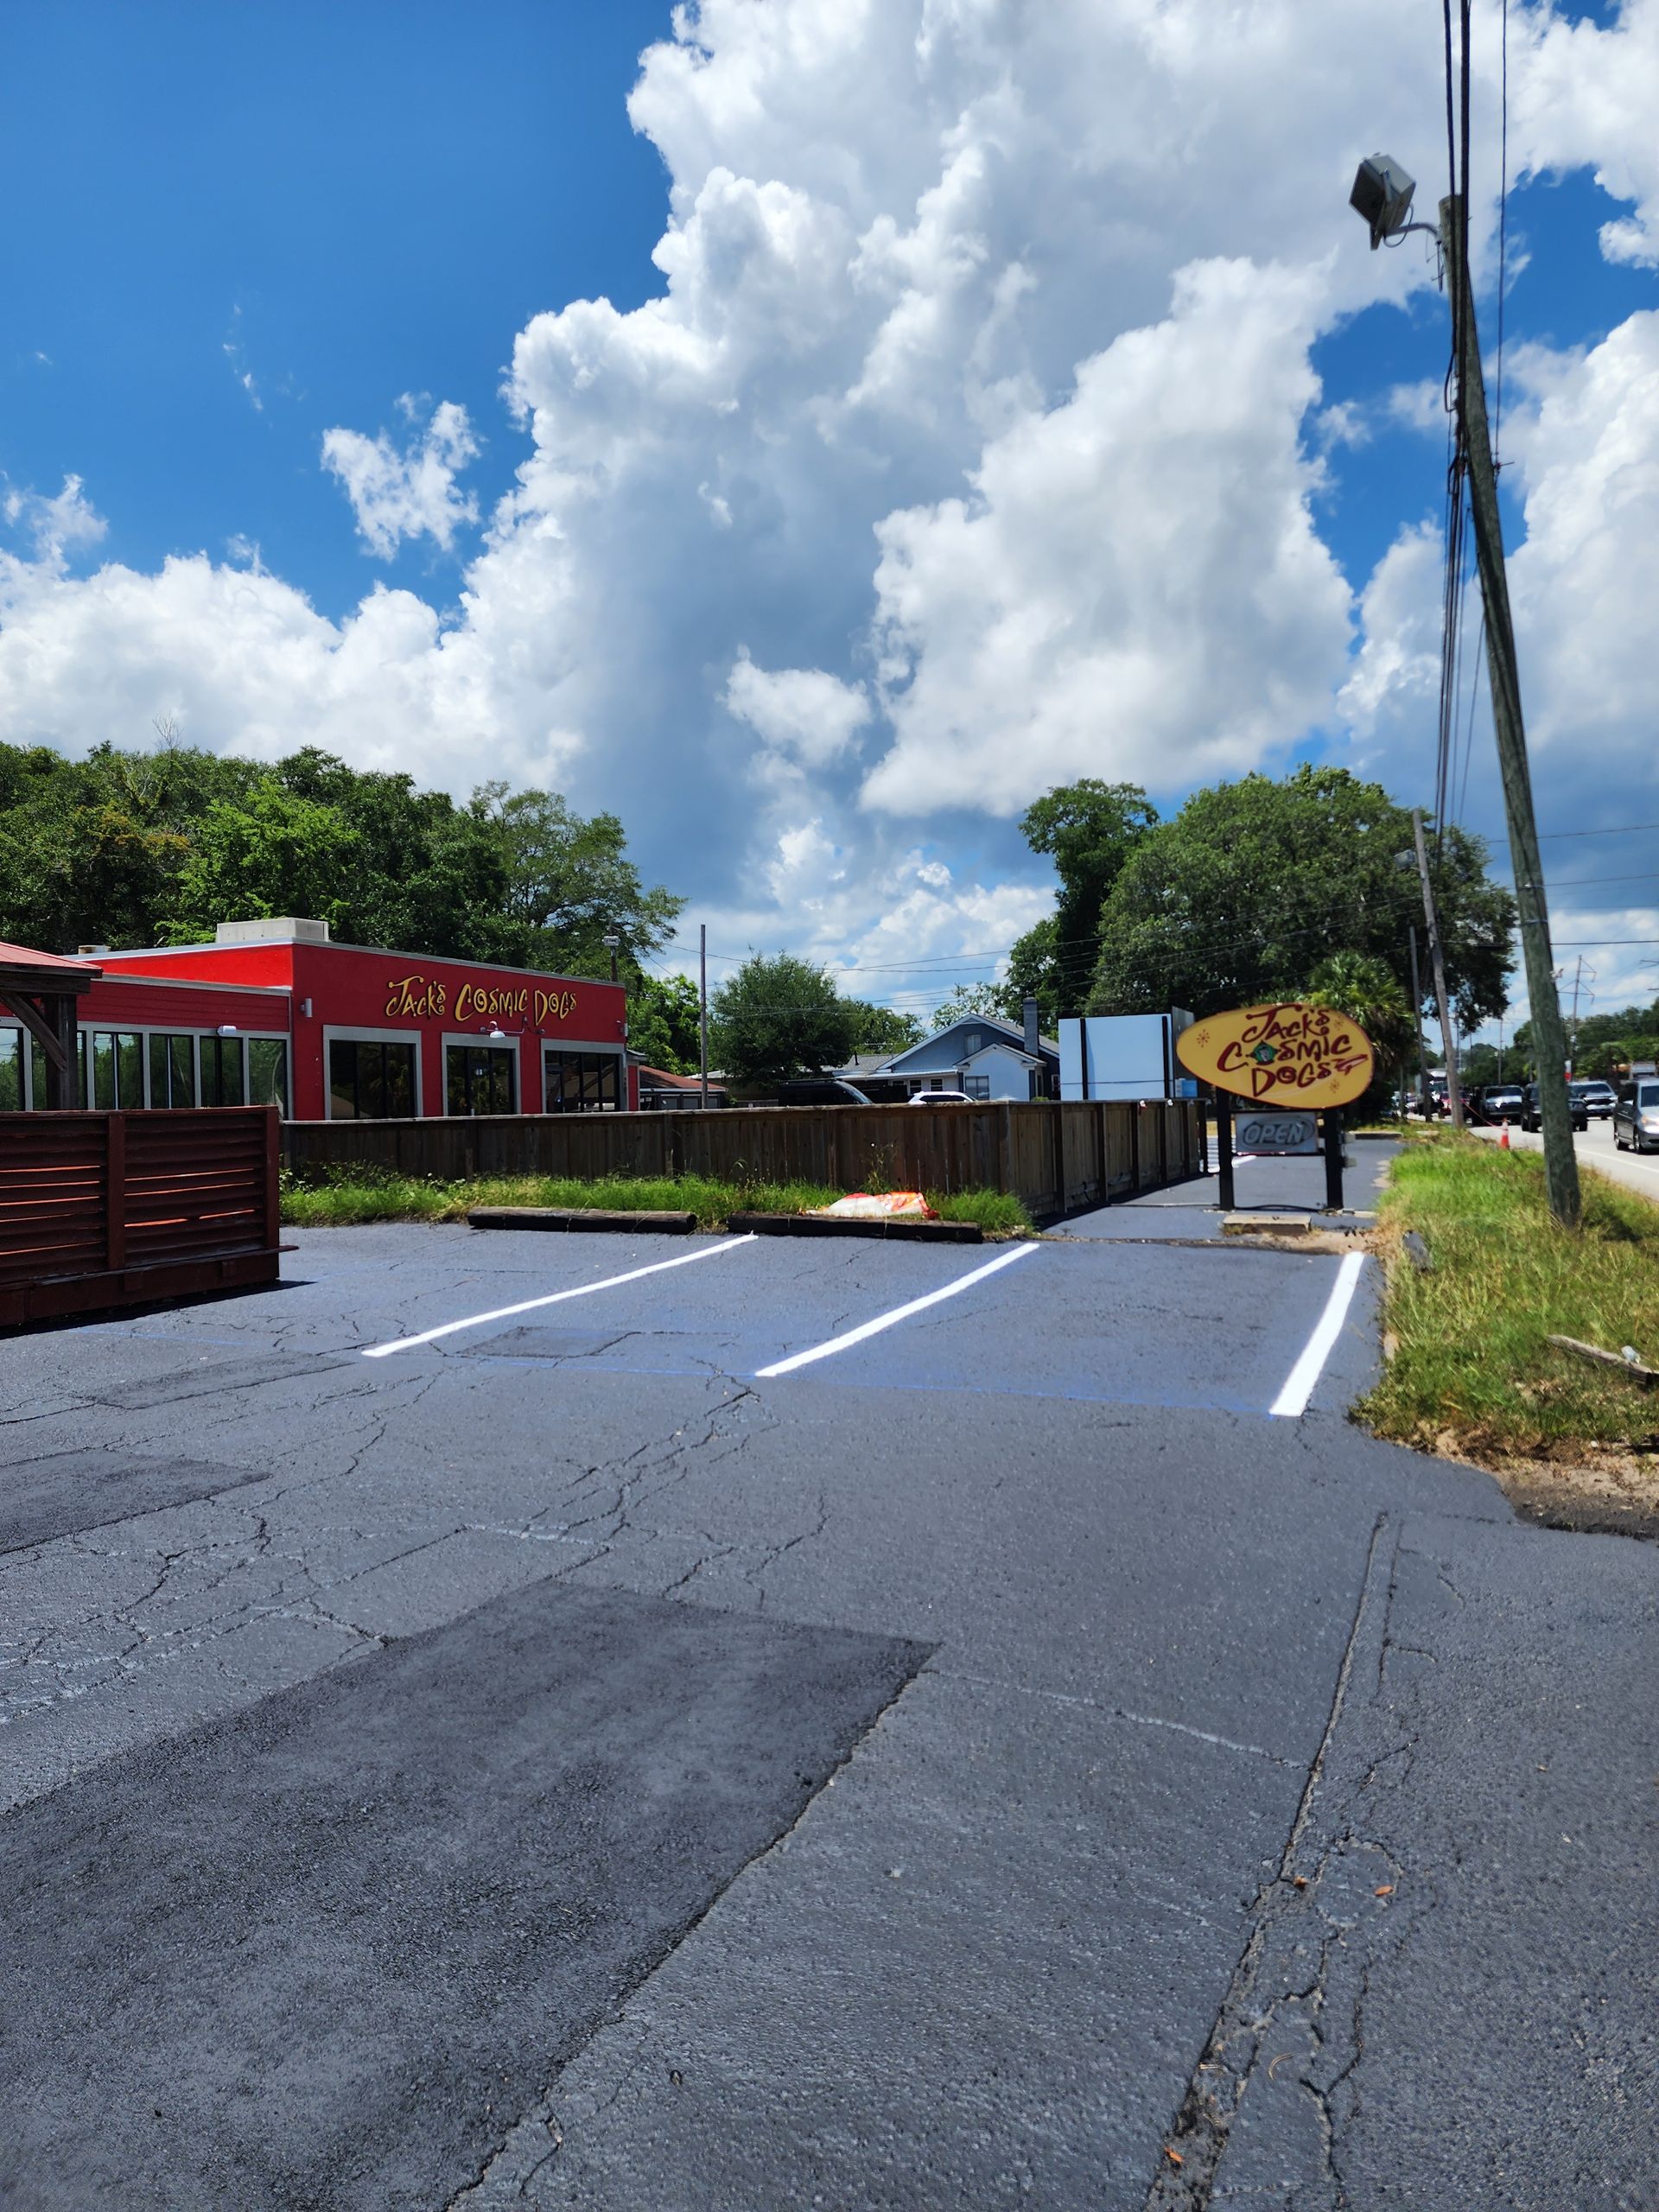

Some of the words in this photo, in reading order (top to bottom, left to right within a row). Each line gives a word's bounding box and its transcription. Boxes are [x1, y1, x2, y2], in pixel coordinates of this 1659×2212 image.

[454, 983, 528, 1021] COSMIC
[534, 988, 578, 1027] DOGS
[1217, 1035, 1352, 1072] COSMIC
[1251, 1063, 1332, 1097] DOGS
[1244, 1122, 1305, 1146] OPEN
